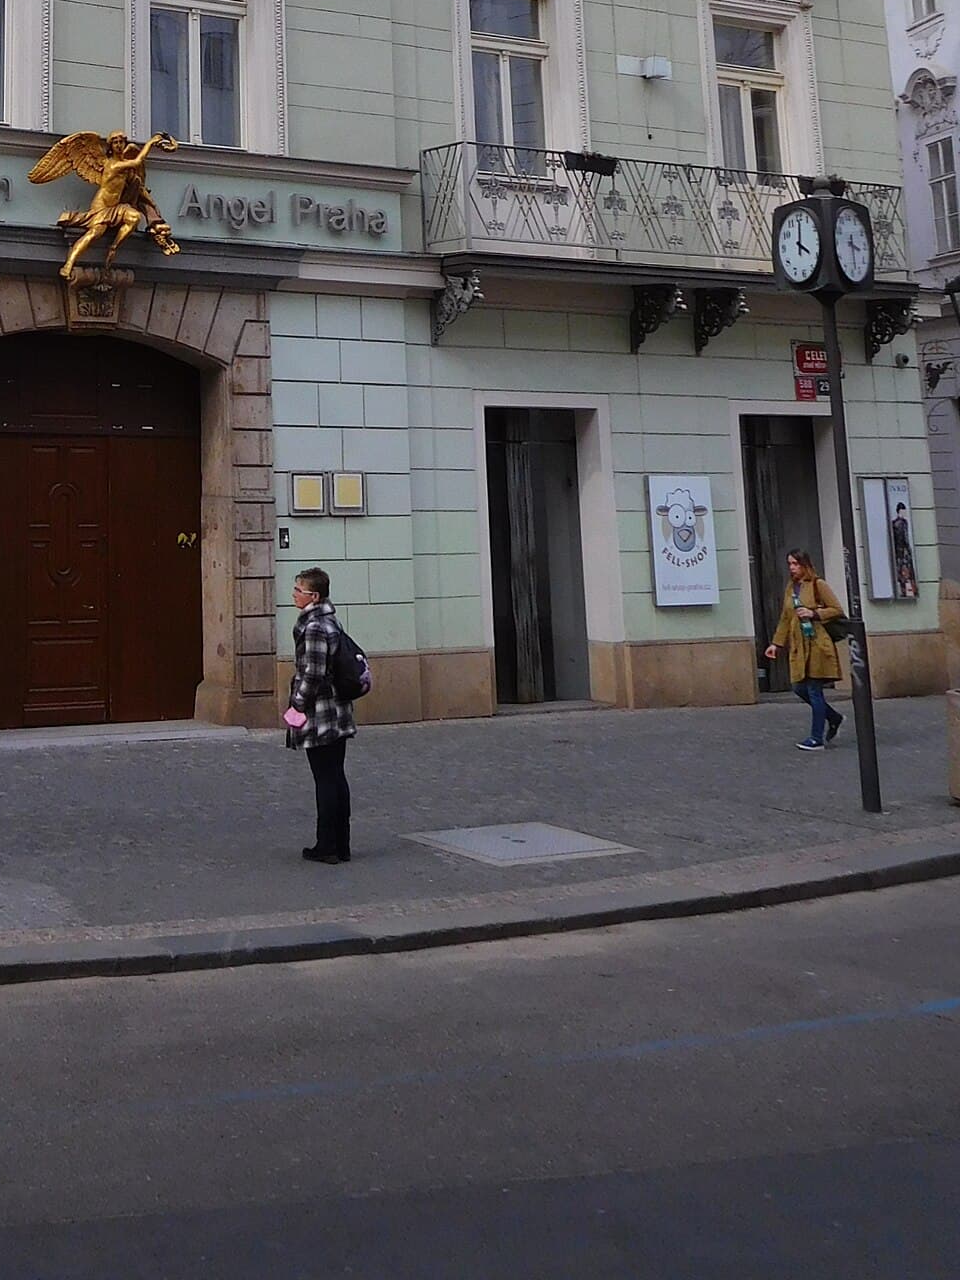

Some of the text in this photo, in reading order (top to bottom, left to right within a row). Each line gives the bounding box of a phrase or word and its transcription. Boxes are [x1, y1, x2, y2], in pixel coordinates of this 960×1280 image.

[177, 183, 278, 231] Angel
[290, 192, 389, 235] Praha
[661, 546, 708, 568] FELL-SHOP
